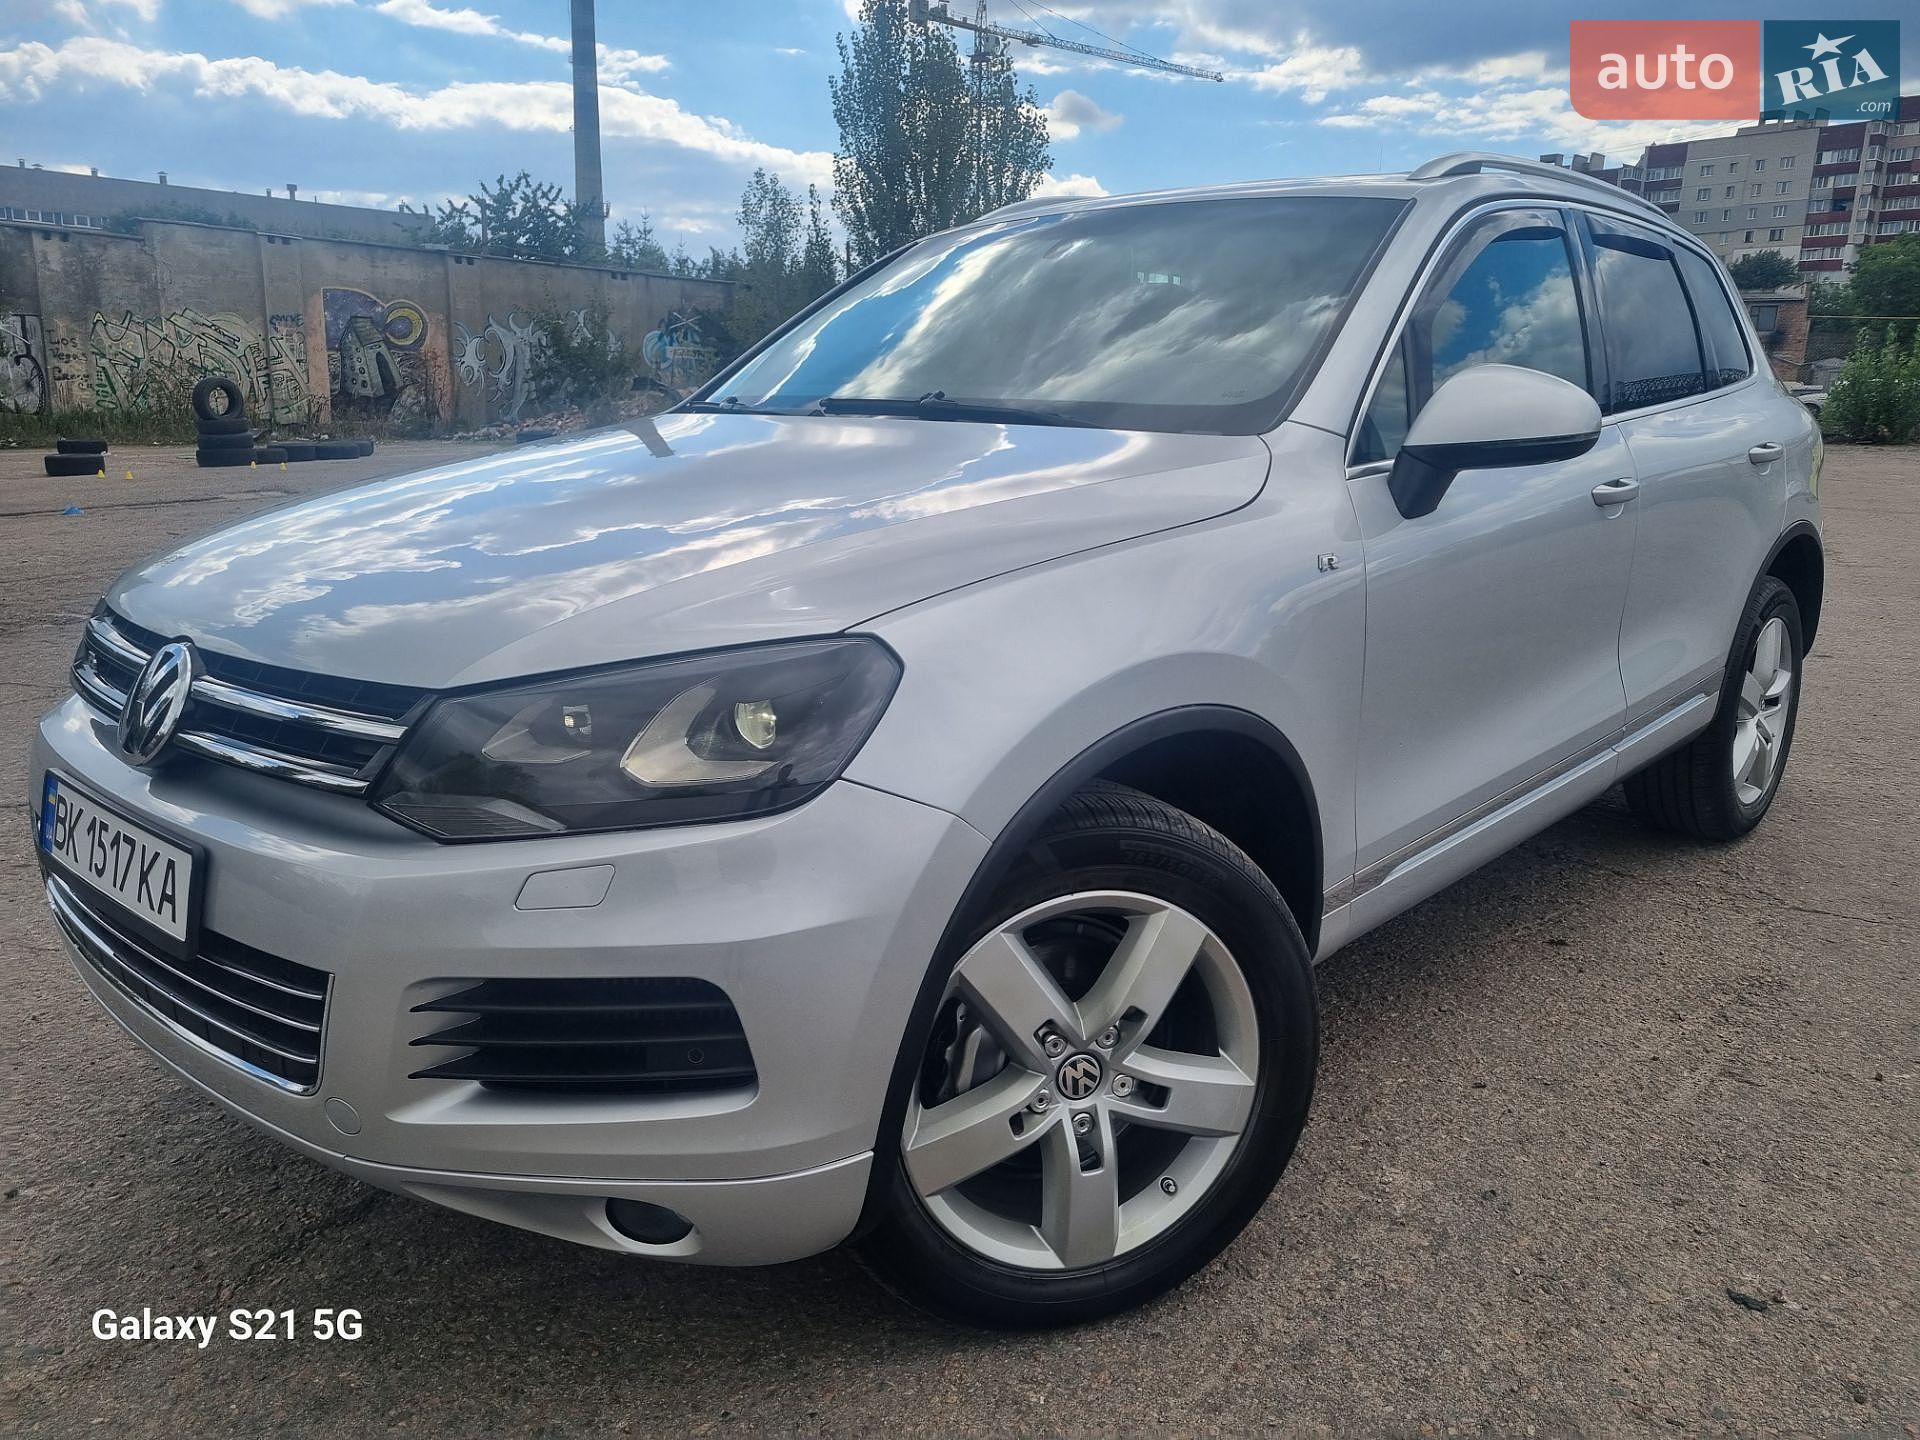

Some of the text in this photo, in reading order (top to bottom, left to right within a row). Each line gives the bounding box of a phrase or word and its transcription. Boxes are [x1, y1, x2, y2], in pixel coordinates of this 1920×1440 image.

[54, 794, 177, 923] BK 1517 KA
